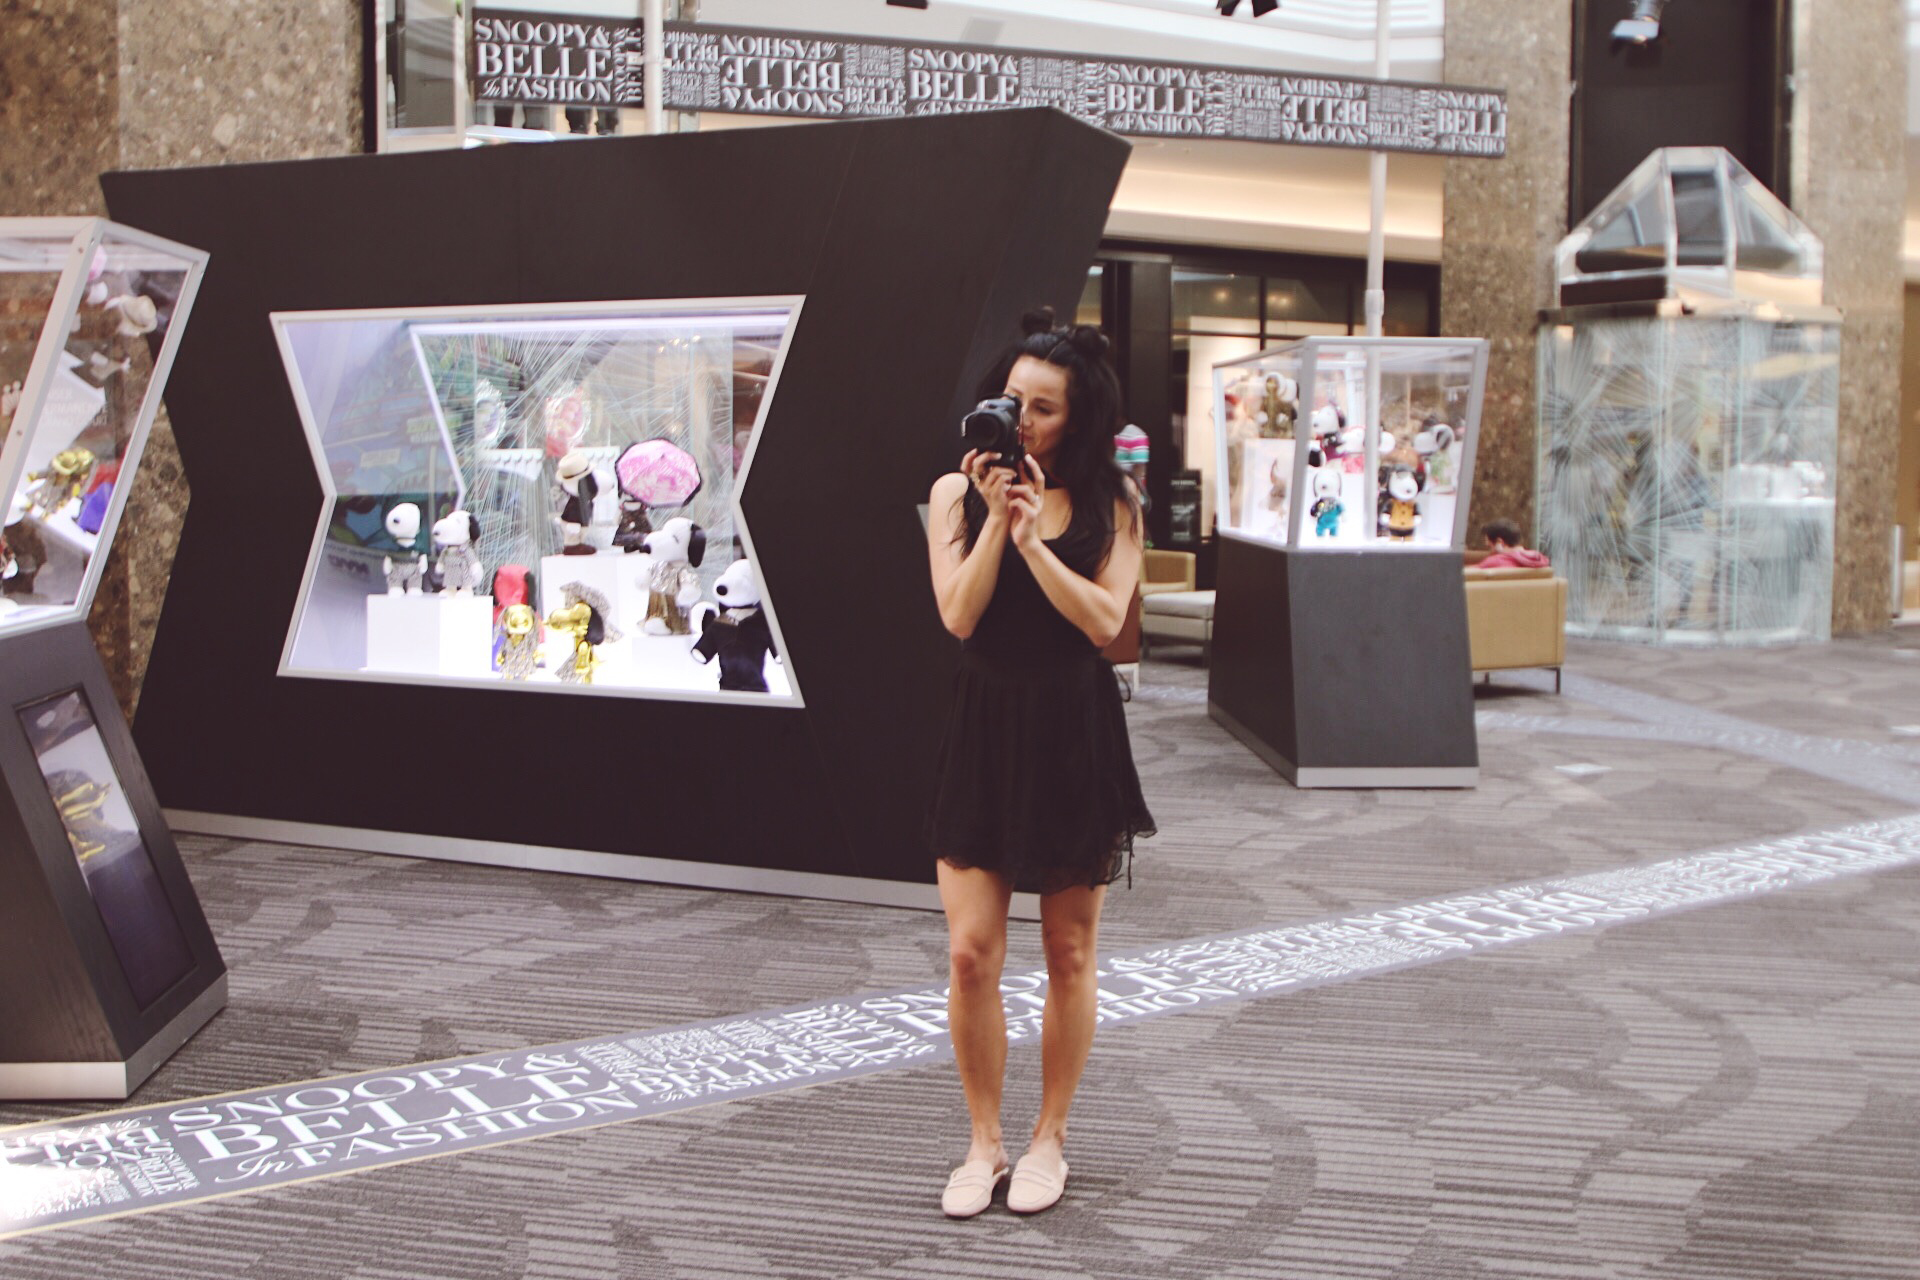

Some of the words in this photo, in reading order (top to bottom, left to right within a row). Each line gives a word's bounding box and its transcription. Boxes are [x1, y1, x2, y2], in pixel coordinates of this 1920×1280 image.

[477, 42, 614, 81] BELLE
[721, 55, 844, 91] BELLE
[500, 77, 612, 103] FASHION
[909, 70, 1021, 104] BELLE
[1108, 83, 1205, 117] BELLE
[1281, 93, 1368, 126] BELLE
[629, 1050, 828, 1095] BELLE
[168, 1057, 515, 1132] SNOOPY
[524, 1053, 580, 1072] &
[179, 1067, 621, 1163] BELLE
[215, 1151, 293, 1183] In
[284, 1091, 639, 1170] FASHION
